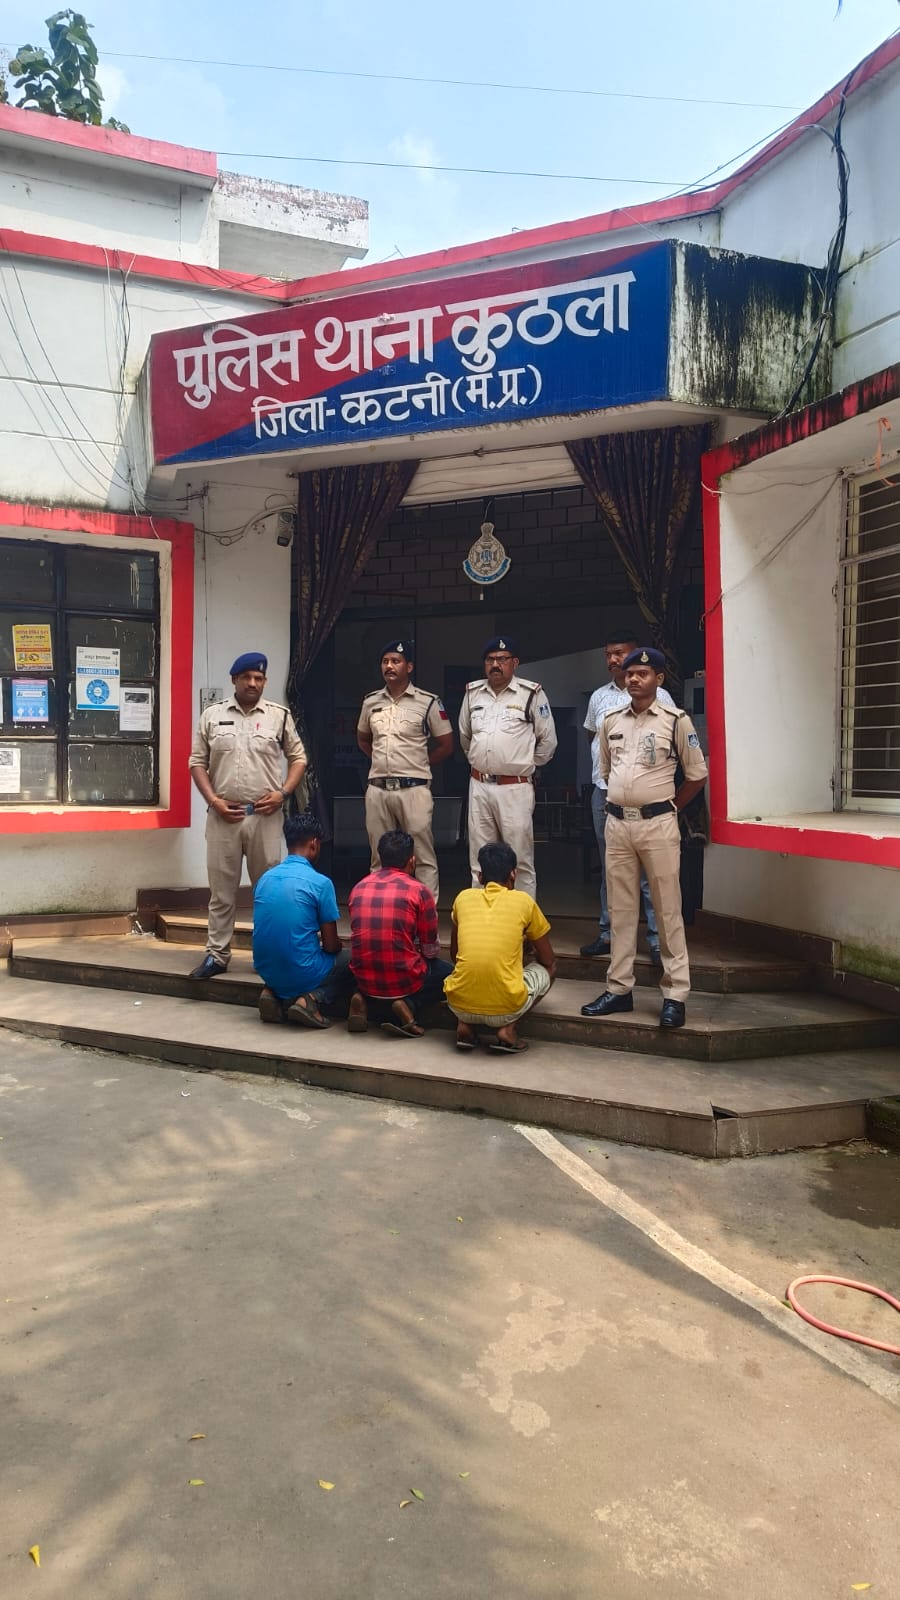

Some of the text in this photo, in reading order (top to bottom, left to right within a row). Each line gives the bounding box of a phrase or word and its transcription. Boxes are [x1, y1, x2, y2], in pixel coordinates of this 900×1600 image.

[172, 271, 636, 409] पुलिस थाना कुठला
